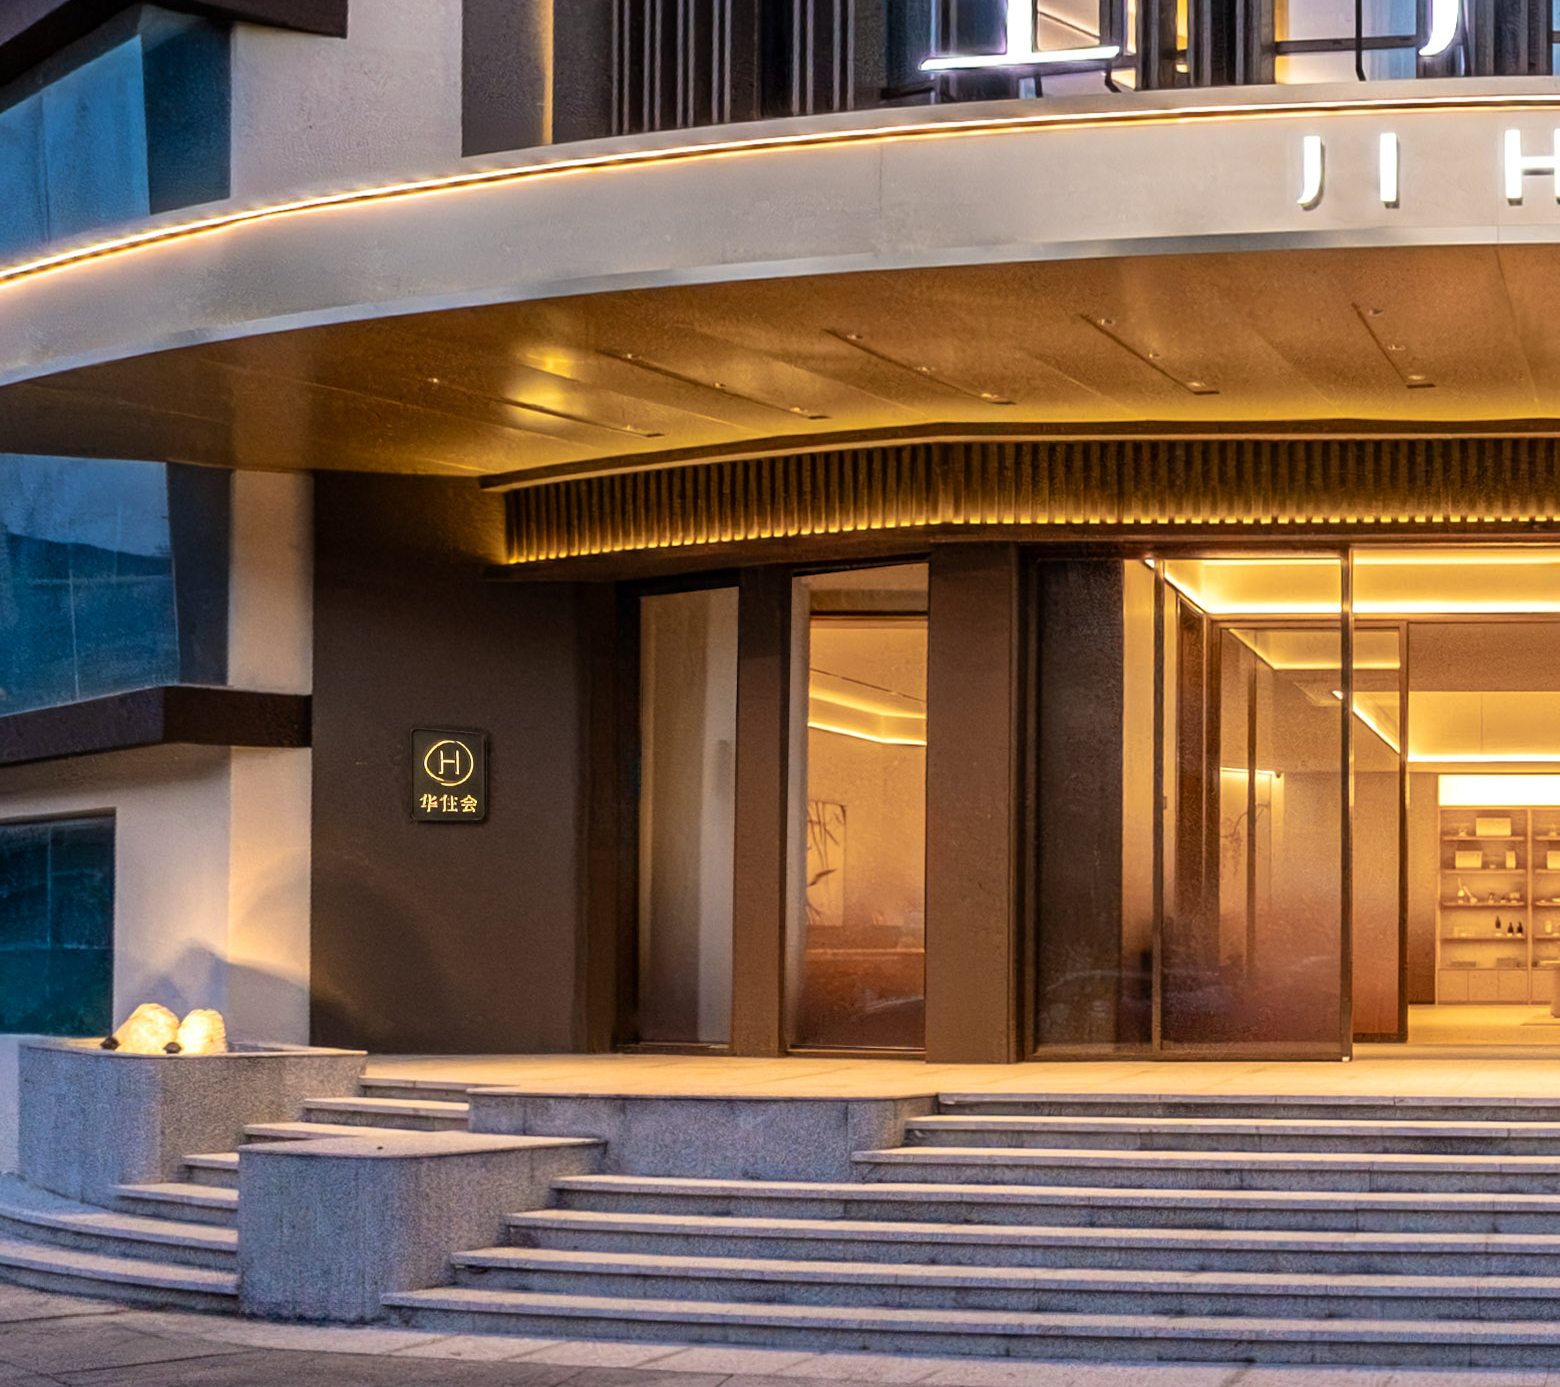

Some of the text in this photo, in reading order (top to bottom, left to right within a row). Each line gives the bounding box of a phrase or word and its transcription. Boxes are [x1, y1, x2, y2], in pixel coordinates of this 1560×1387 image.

[1295, 134, 1398, 207] JI
[419, 793, 478, 814] 华住会
